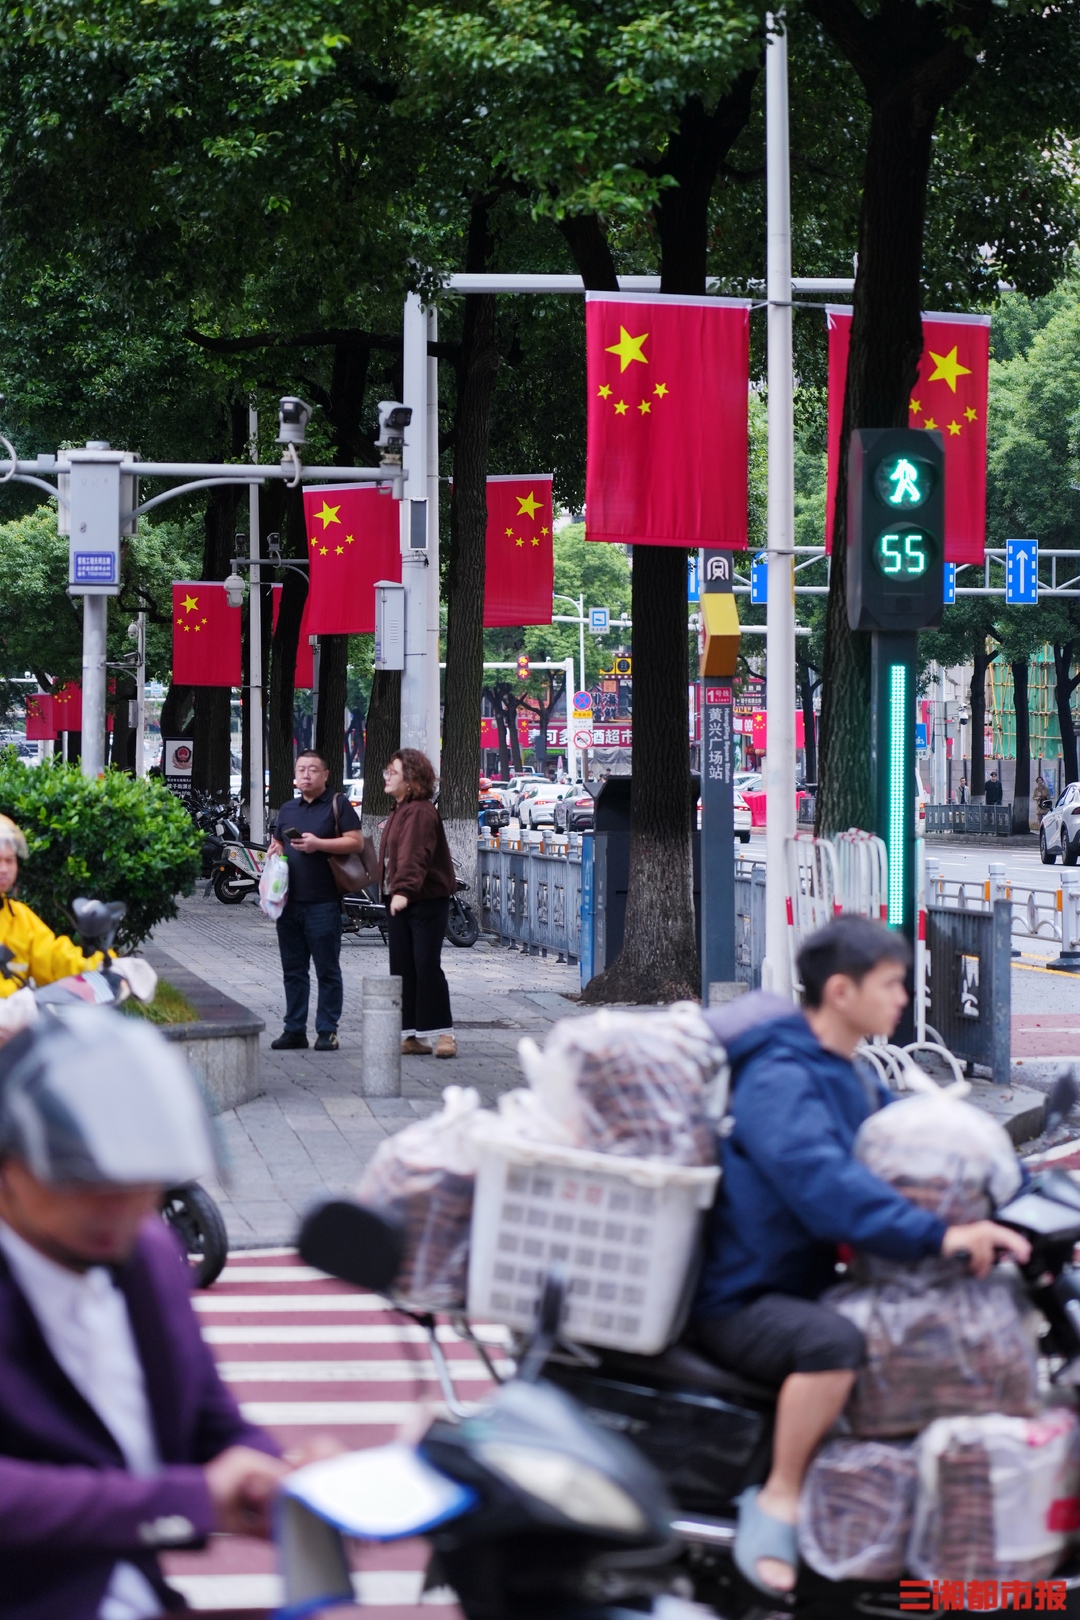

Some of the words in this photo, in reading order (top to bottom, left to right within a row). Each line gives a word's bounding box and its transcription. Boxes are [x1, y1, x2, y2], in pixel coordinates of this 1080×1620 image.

[882, 535, 924, 572] 55
[708, 708, 723, 780] 黄兴广场站
